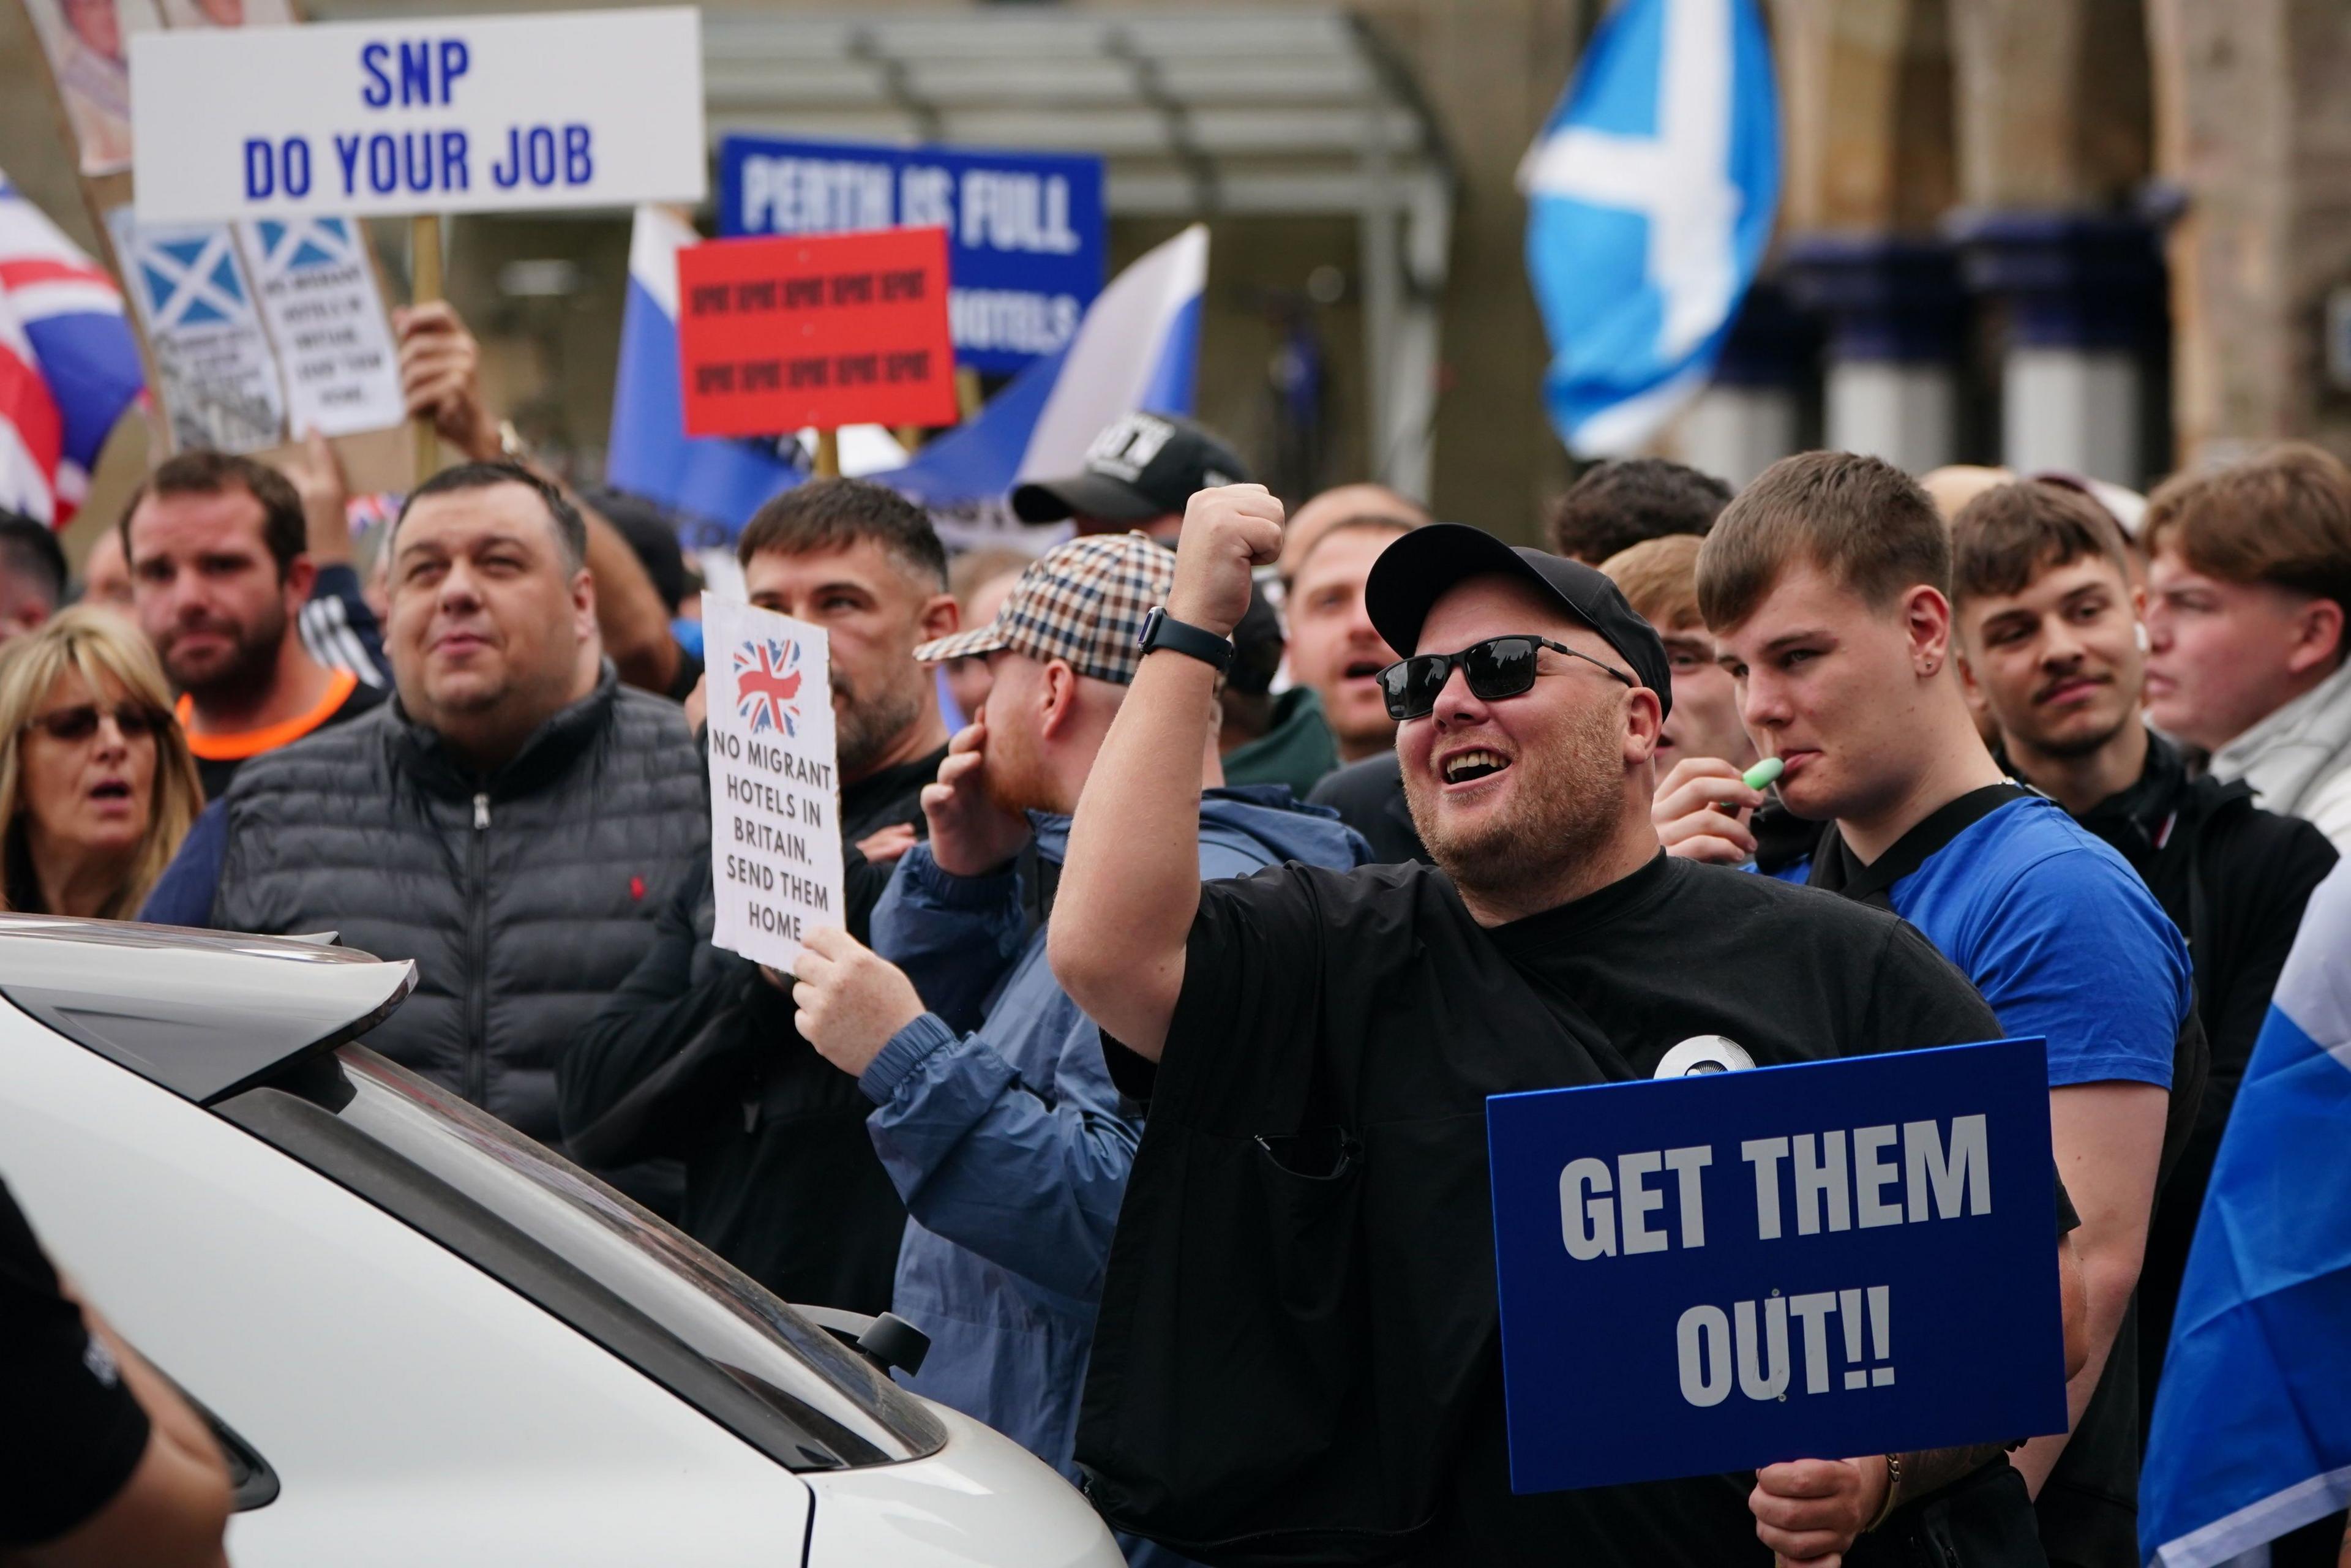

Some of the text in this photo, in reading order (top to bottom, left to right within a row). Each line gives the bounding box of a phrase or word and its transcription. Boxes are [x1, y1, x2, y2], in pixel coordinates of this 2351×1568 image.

[361, 39, 470, 108] SNP
[244, 125, 594, 201] DO YOUR JOB
[741, 154, 893, 233] PERTH
[960, 168, 1082, 255] FULL
[713, 729, 831, 790] NO MIGRANT
[727, 774, 821, 828] HOTELS IN
[734, 816, 812, 865] BRITAIN.
[726, 854, 828, 912] SEND THEM
[748, 901, 801, 942] HOME
[1559, 1114, 1991, 1261] GET THEM
[1676, 1285, 1895, 1407] OUT!!
